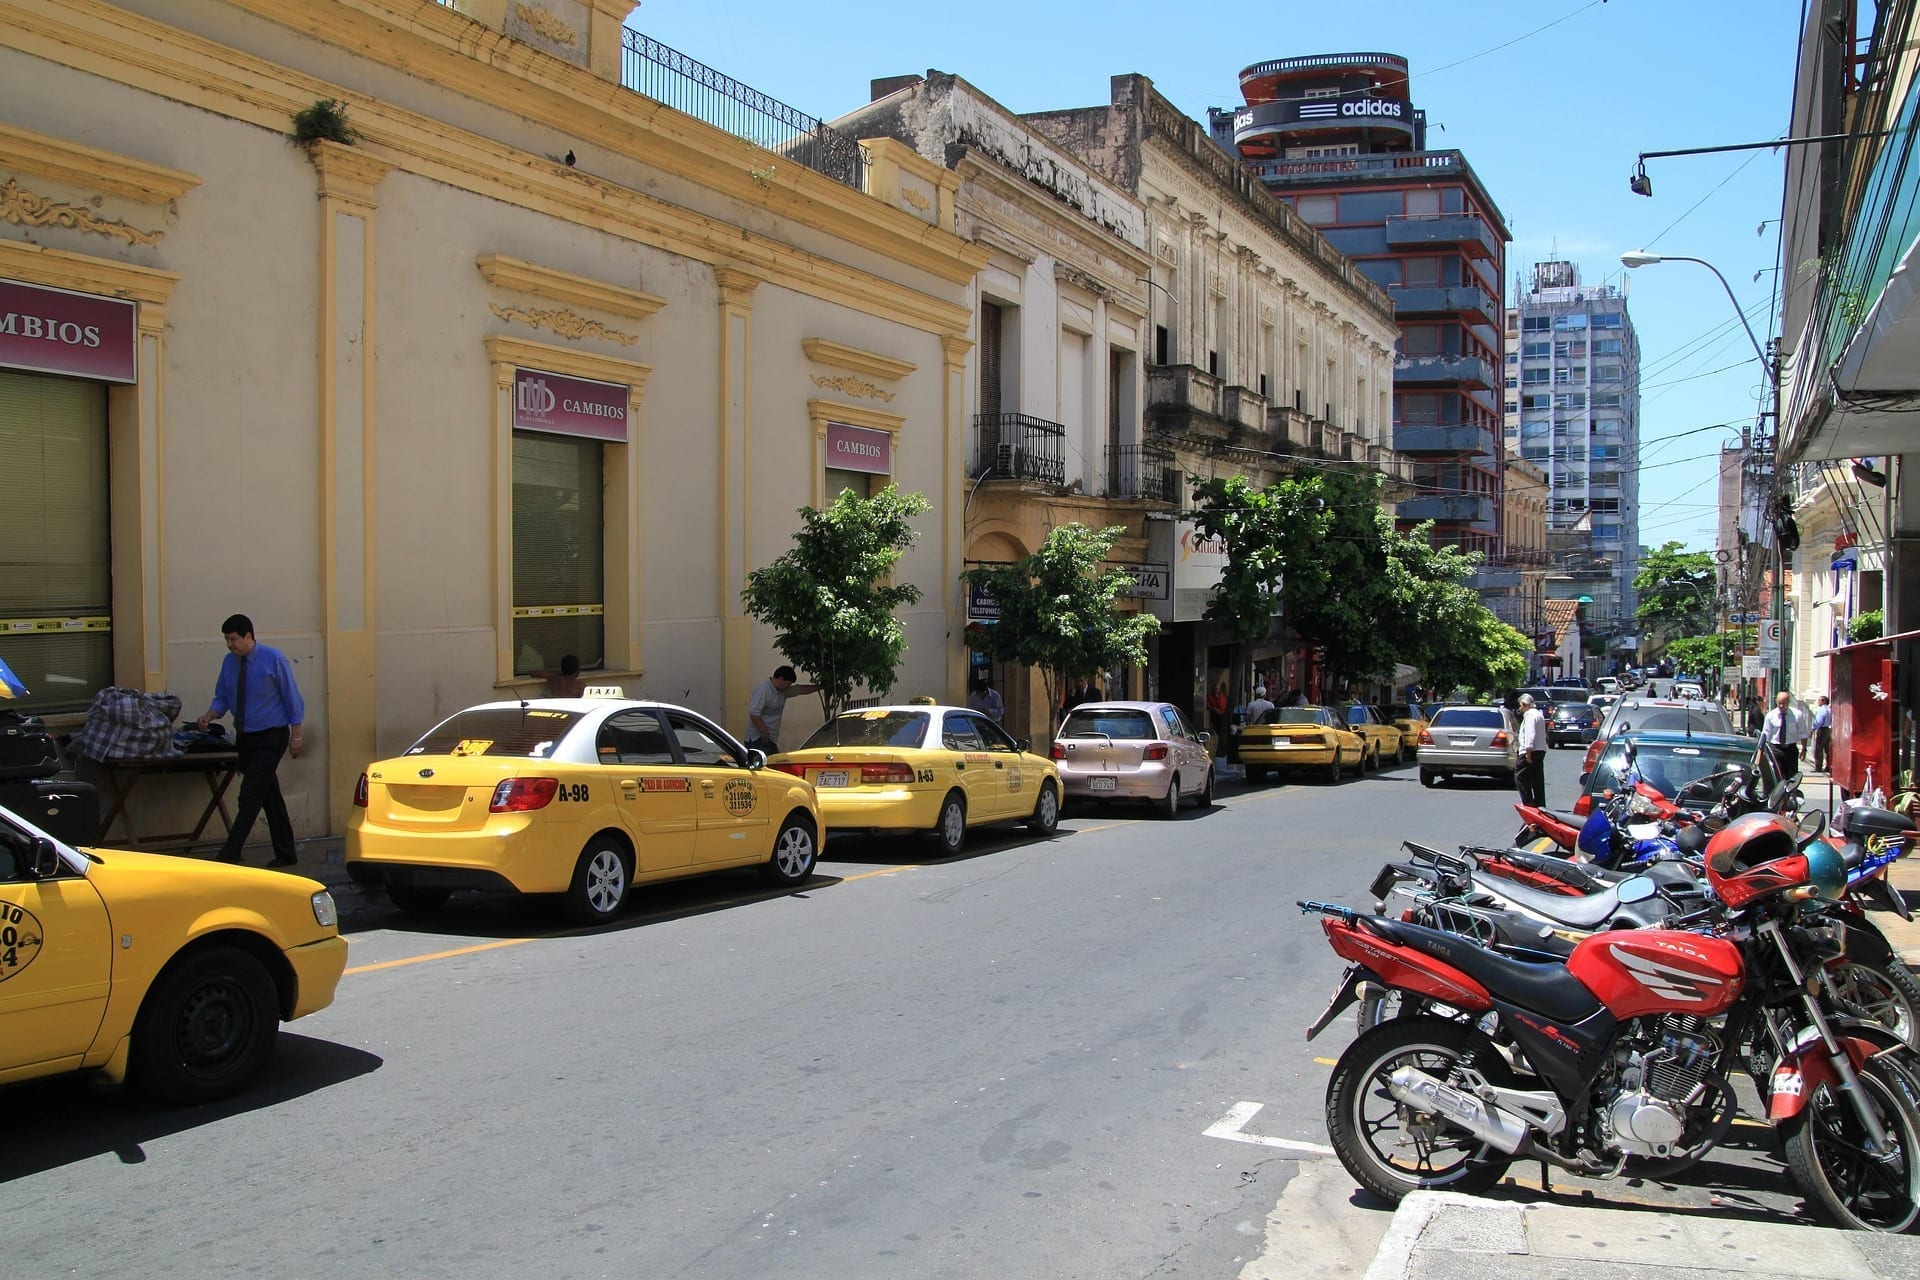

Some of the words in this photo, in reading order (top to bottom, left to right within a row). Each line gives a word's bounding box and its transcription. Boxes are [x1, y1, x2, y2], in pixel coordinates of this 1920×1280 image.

[1341, 100, 1401, 117] adidas
[0, 312, 101, 348] MBIOS
[562, 399, 625, 420] CAMBIOS
[836, 439, 881, 458] CAMBIOS
[589, 688, 617, 696] TAXI
[833, 776, 847, 787] 717
[917, 769, 935, 783] A-63
[558, 783, 590, 803] A-98
[0, 926, 18, 948] 0
[0, 947, 18, 968] 4
[1426, 940, 1452, 958] TAIGA
[1656, 941, 1709, 961] TAIGA
